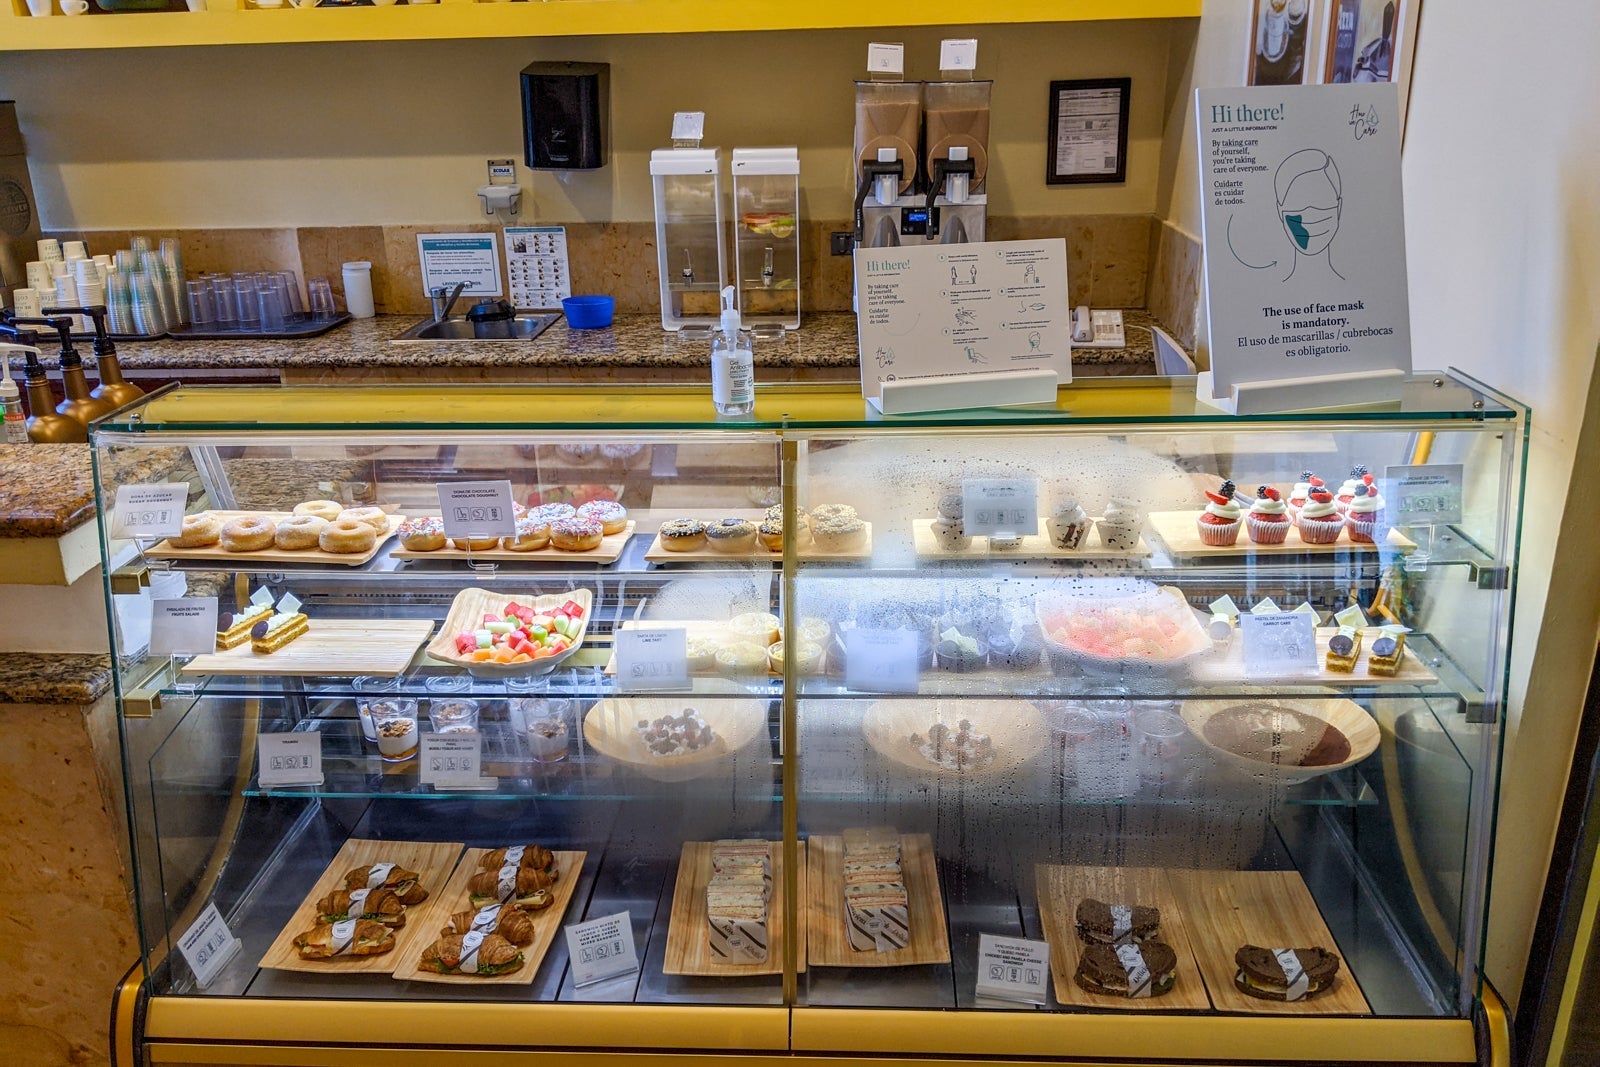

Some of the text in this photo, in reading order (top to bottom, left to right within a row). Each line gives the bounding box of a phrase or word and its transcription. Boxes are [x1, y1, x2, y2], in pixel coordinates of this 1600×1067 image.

[1212, 103, 1284, 123] Hi there!
[1355, 119, 1377, 140] Care
[1221, 147, 1250, 156] yourself,
[1213, 156, 1256, 166] you're taking
[1237, 165, 1269, 173] everyone.
[867, 259, 910, 271] Hi there!
[1263, 300, 1364, 317] The use of face mask
[1282, 316, 1350, 330] is mandatory.
[1238, 326, 1393, 347] El uso de mascarillas / cubrebocas
[1286, 344, 1351, 357] es obligatorio.
